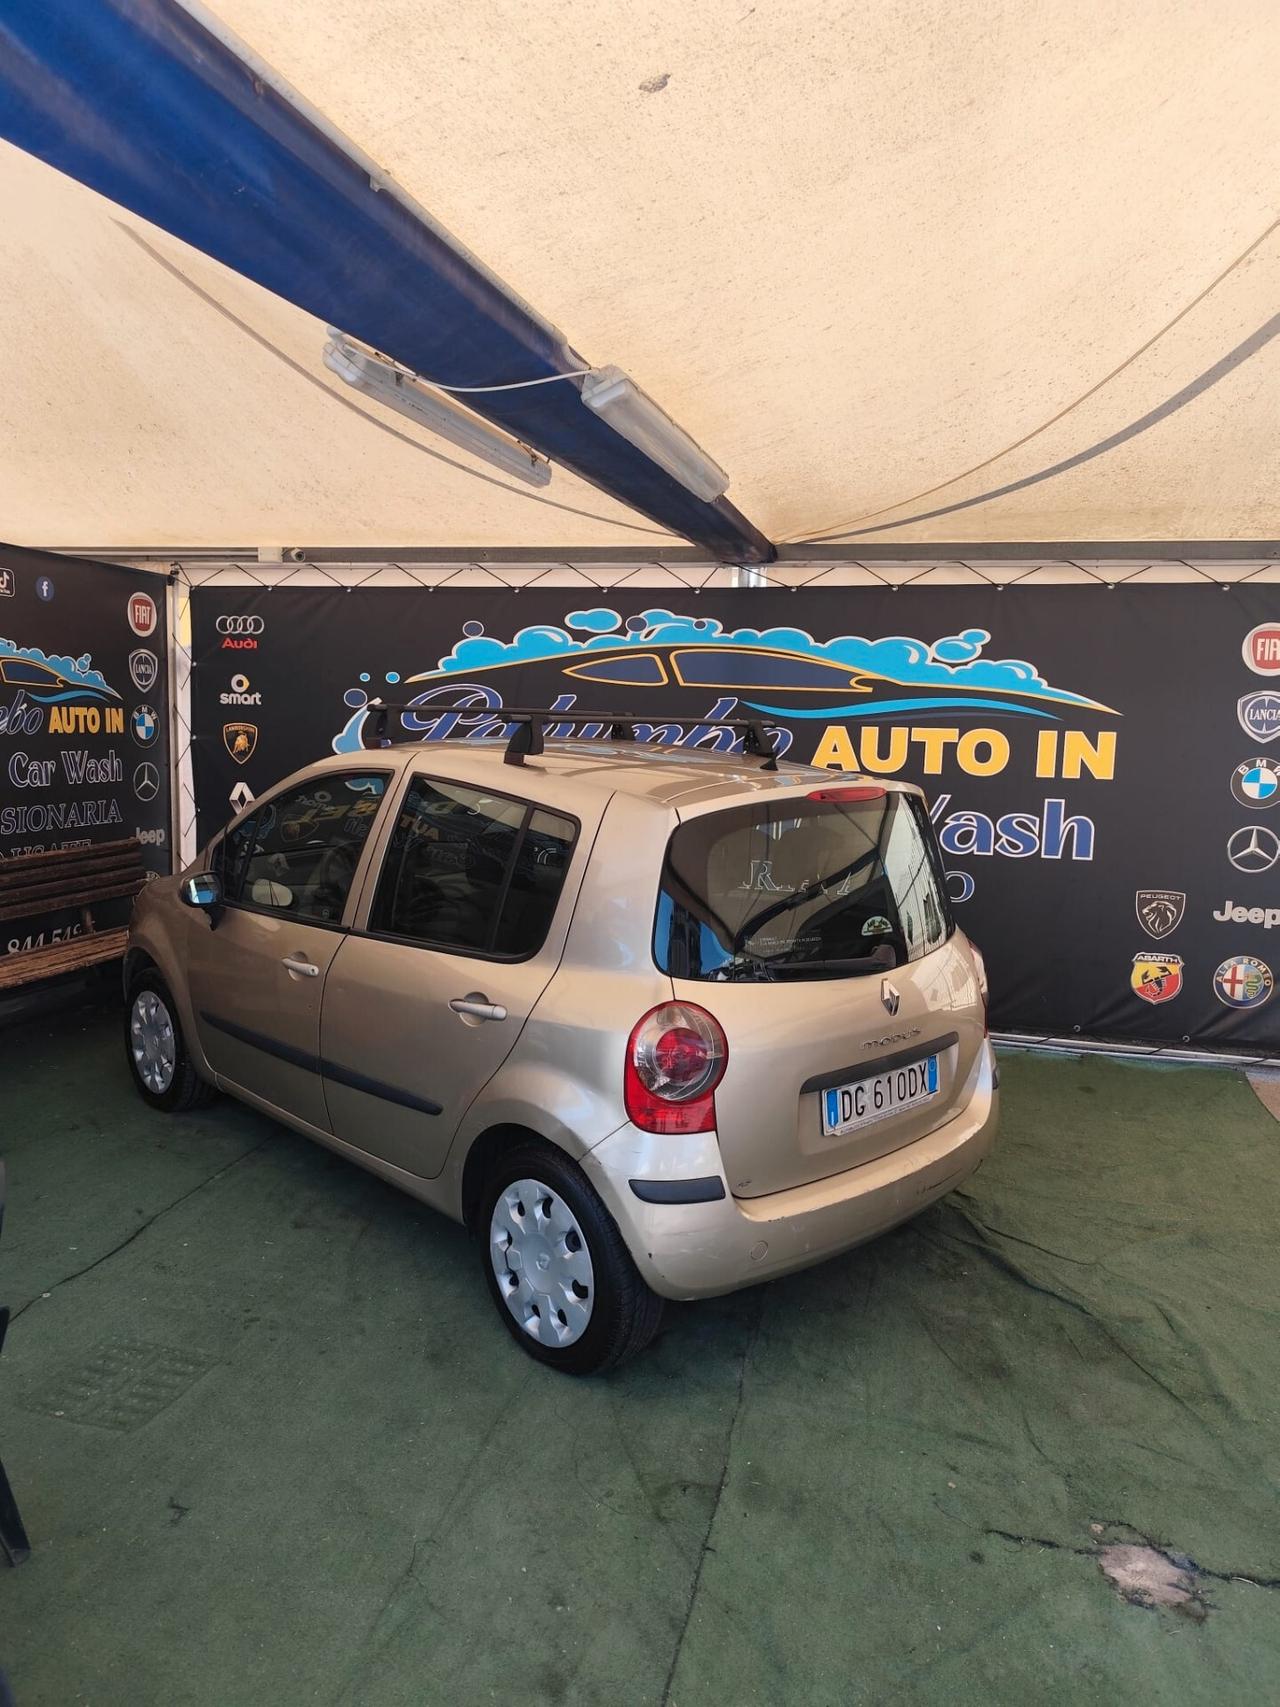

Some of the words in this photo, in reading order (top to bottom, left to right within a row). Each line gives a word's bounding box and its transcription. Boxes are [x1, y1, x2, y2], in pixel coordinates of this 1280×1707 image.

[134, 604, 151, 625] FIAT
[221, 637, 258, 649] Audi
[220, 692, 262, 705] smart
[48, 706, 101, 734] AUTO
[105, 708, 124, 734] IN
[133, 706, 159, 720] BMW
[810, 725, 1010, 777] AUTO
[1035, 730, 1117, 780] IN
[8, 751, 56, 788] Car
[61, 749, 123, 785] Wash
[1140, 893, 1182, 901] PEUGEOT
[1212, 900, 1280, 929] Jeep
[1137, 955, 1178, 964] ABARTH
[1243, 958, 1272, 987] ROMEO
[841, 1086, 866, 1122] DG
[873, 1062, 928, 1109] 610DX
